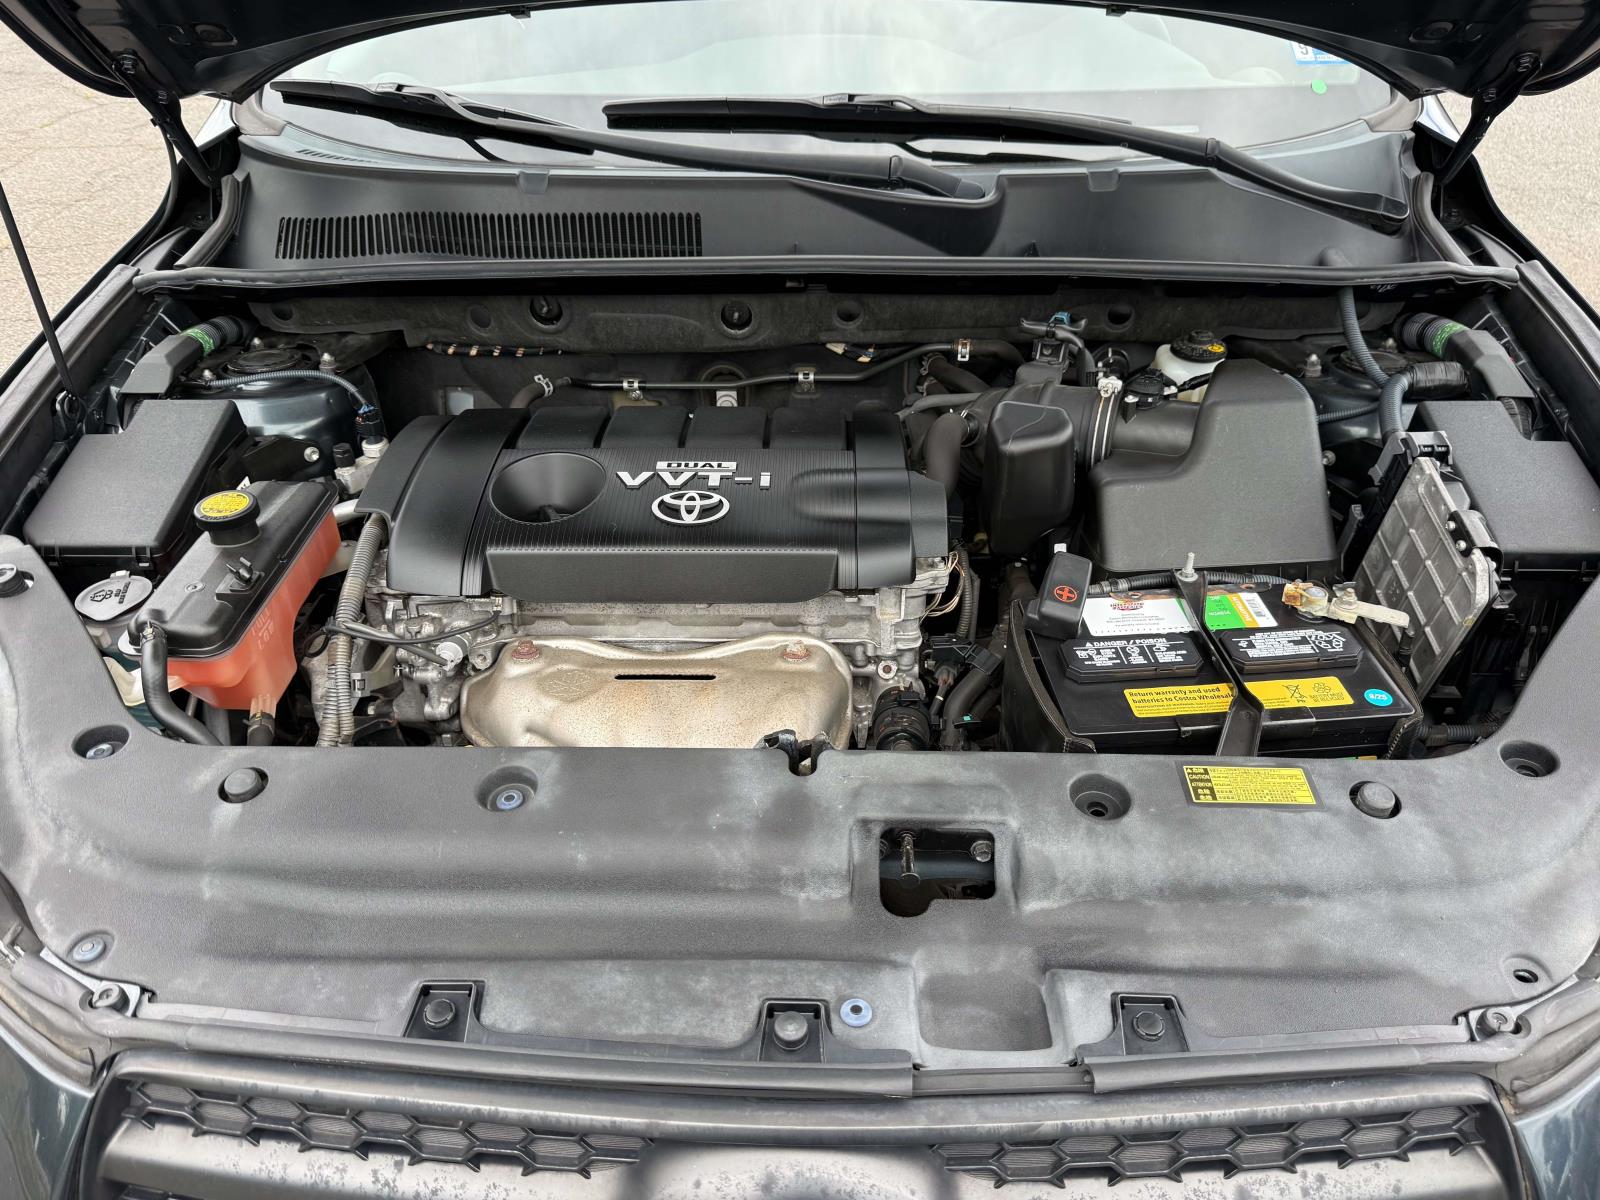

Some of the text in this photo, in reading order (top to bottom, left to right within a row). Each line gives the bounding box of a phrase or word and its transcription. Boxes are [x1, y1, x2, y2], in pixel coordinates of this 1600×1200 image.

[665, 462, 732, 470] DUAL
[616, 472, 771, 489] VVT-i
[1154, 688, 1187, 697] warranty
[1132, 696, 1165, 704] batteries
[1173, 694, 1198, 702] Costco
